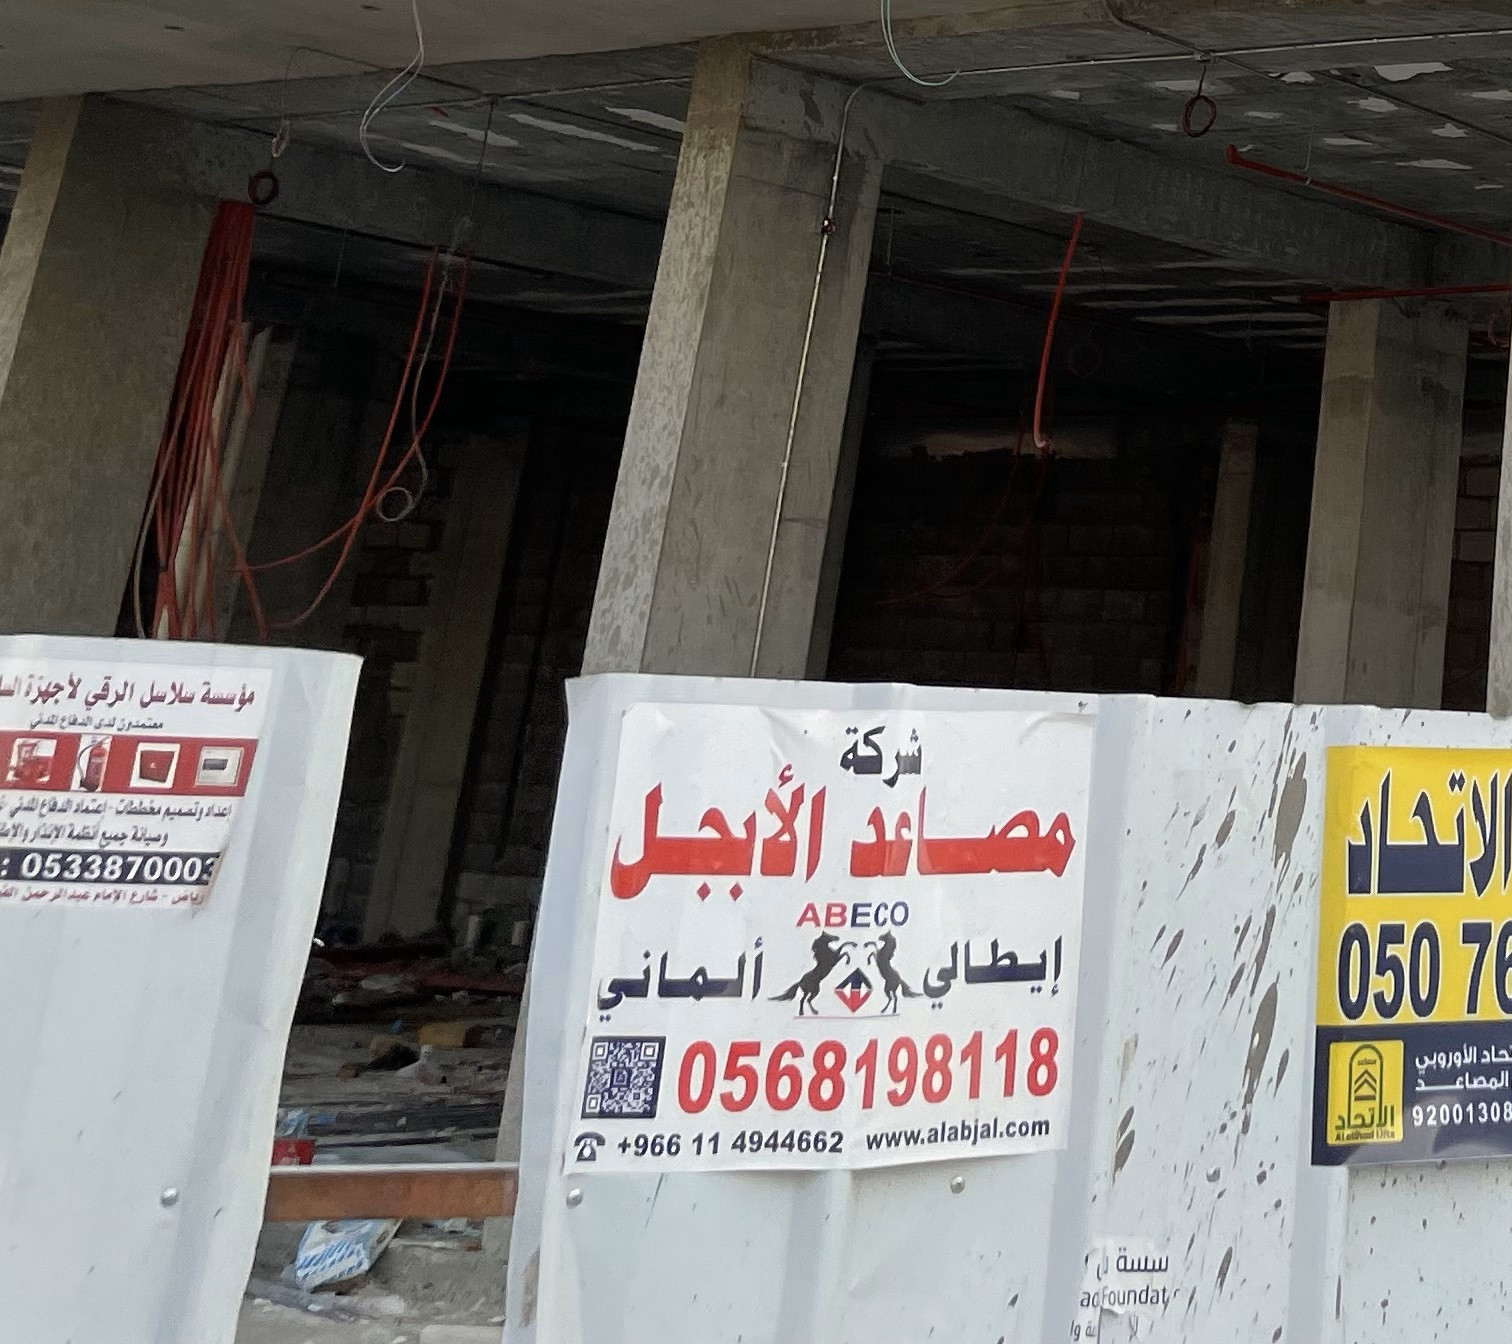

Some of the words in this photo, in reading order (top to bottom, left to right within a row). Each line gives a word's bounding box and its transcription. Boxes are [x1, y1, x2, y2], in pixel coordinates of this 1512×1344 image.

[200, 681, 255, 712] مؤسسة
[840, 726, 922, 787] شركة
[610, 763, 826, 901] الأبجل
[850, 787, 1076, 878] مصاعد
[796, 901, 910, 928] ABECO
[597, 936, 764, 1022] ألماني
[923, 935, 1062, 1008] إيطالي
[1337, 920, 1440, 1021] 050
[677, 1026, 1060, 1115] 0568198118
[617, 1133, 681, 1157] +966
[692, 1132, 720, 1155] 11
[731, 1130, 844, 1154] 4944662
[866, 1117, 1050, 1150] www.alabjal.com
